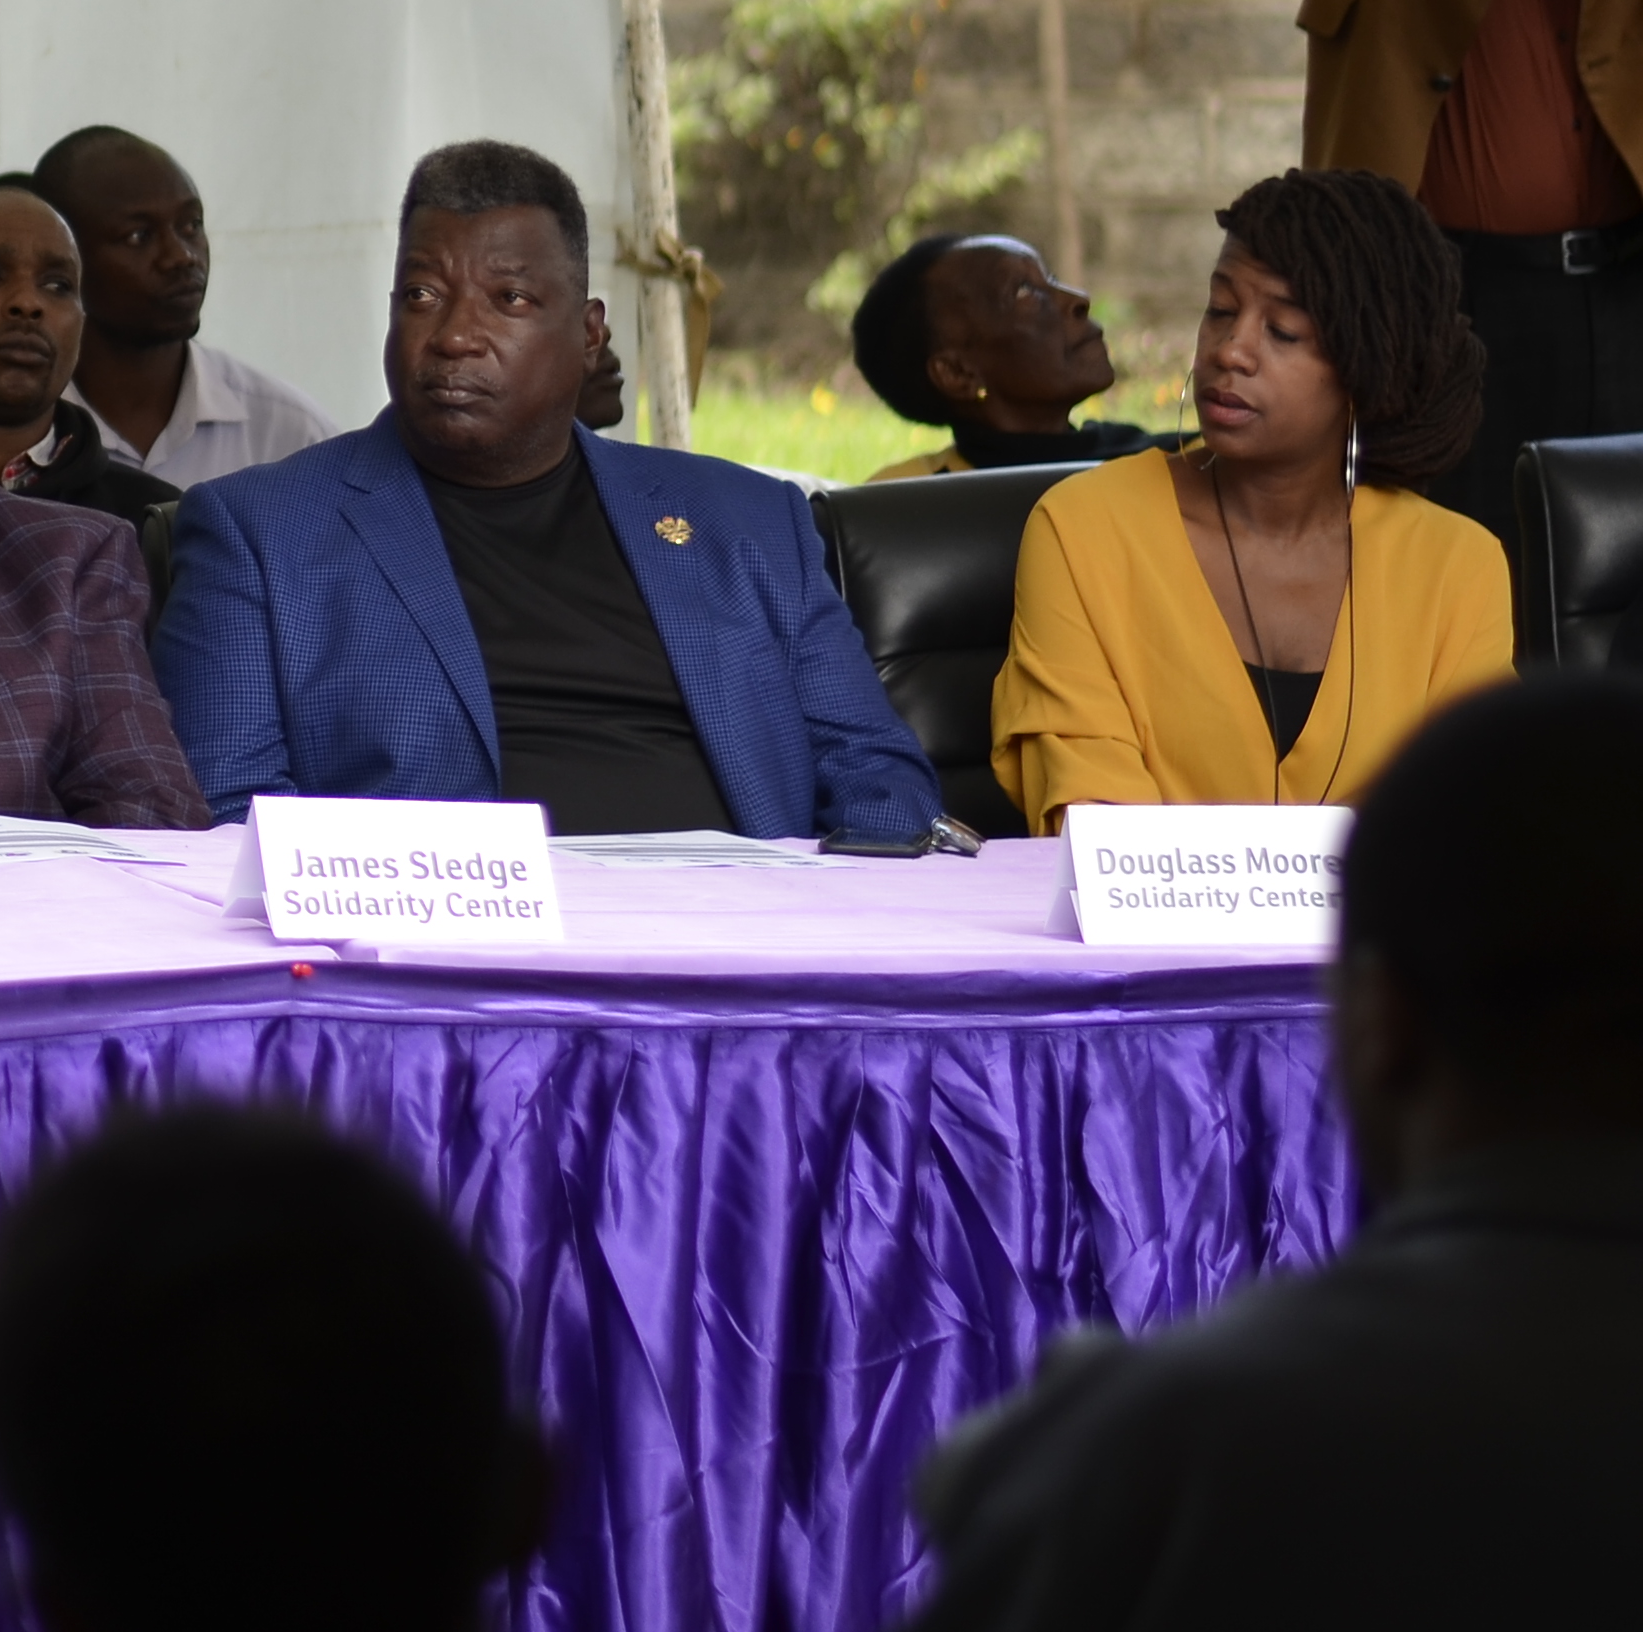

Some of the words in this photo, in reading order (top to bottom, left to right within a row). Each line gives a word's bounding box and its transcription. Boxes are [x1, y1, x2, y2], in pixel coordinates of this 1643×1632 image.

[291, 849, 399, 879] James
[409, 851, 528, 889] Sledge
[1096, 847, 1236, 882] Douglass
[1245, 847, 1342, 874] Moore
[283, 890, 434, 923] Solidarity
[446, 893, 544, 919] Center
[1108, 887, 1240, 913] Solidarity
